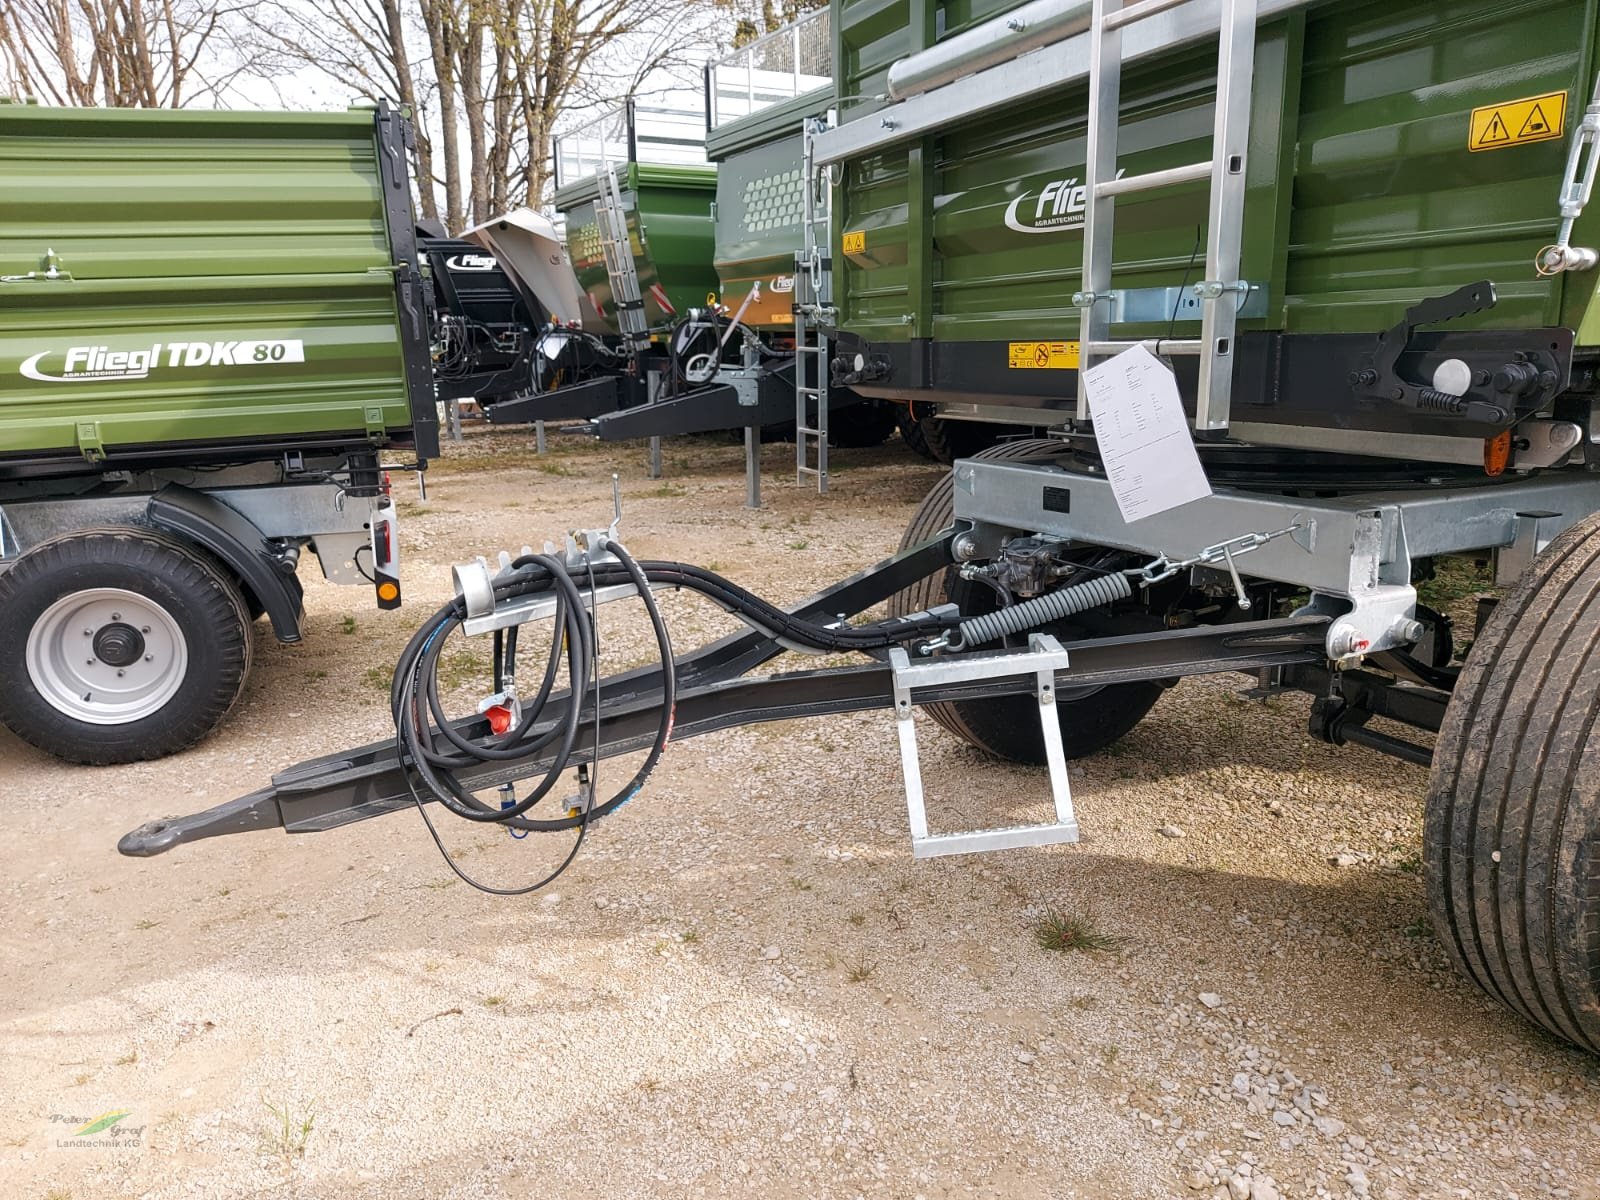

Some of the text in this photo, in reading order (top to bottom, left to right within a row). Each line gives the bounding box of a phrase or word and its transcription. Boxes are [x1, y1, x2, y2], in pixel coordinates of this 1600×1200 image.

[1035, 214, 1084, 227] AGRARTECHNIK
[64, 341, 286, 374] Fliegl TDK 80
